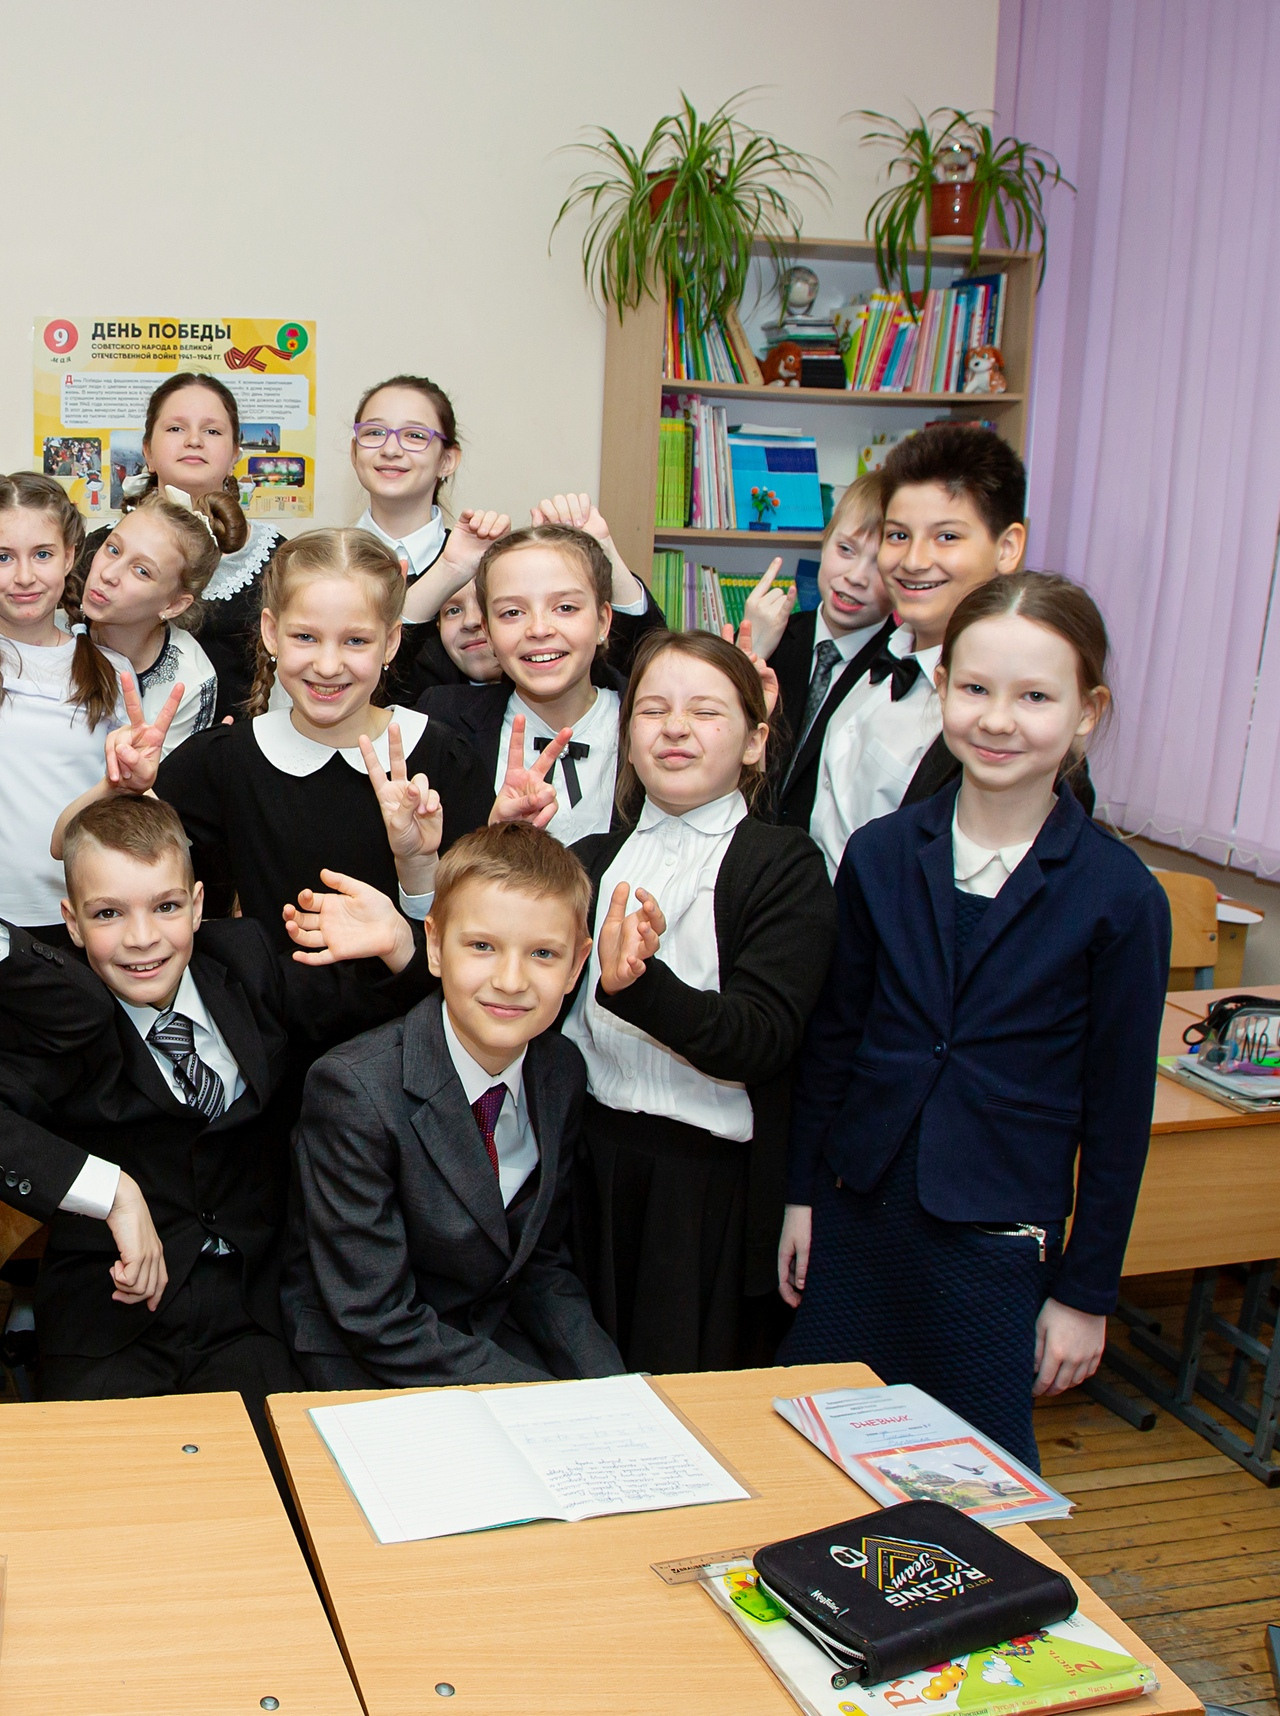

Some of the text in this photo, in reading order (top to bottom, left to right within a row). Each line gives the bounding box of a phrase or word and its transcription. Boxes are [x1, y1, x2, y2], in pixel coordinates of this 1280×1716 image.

[53, 328, 69, 346] 9
[91, 323, 231, 342] ДЕНЬ ПОБЕДЫ
[91, 352, 152, 360] ОТЕЧЕСТВЕННОЙ
[153, 352, 177, 360] ВОЙНЕ
[850, 1414, 913, 1429] ДНЕВНИК
[891, 1552, 936, 1589] Team
[884, 1567, 986, 1607] RACING
[966, 1577, 994, 1590] MOTO
[1049, 1649, 1077, 1677] Часть
[1074, 1659, 1104, 1673] 2
